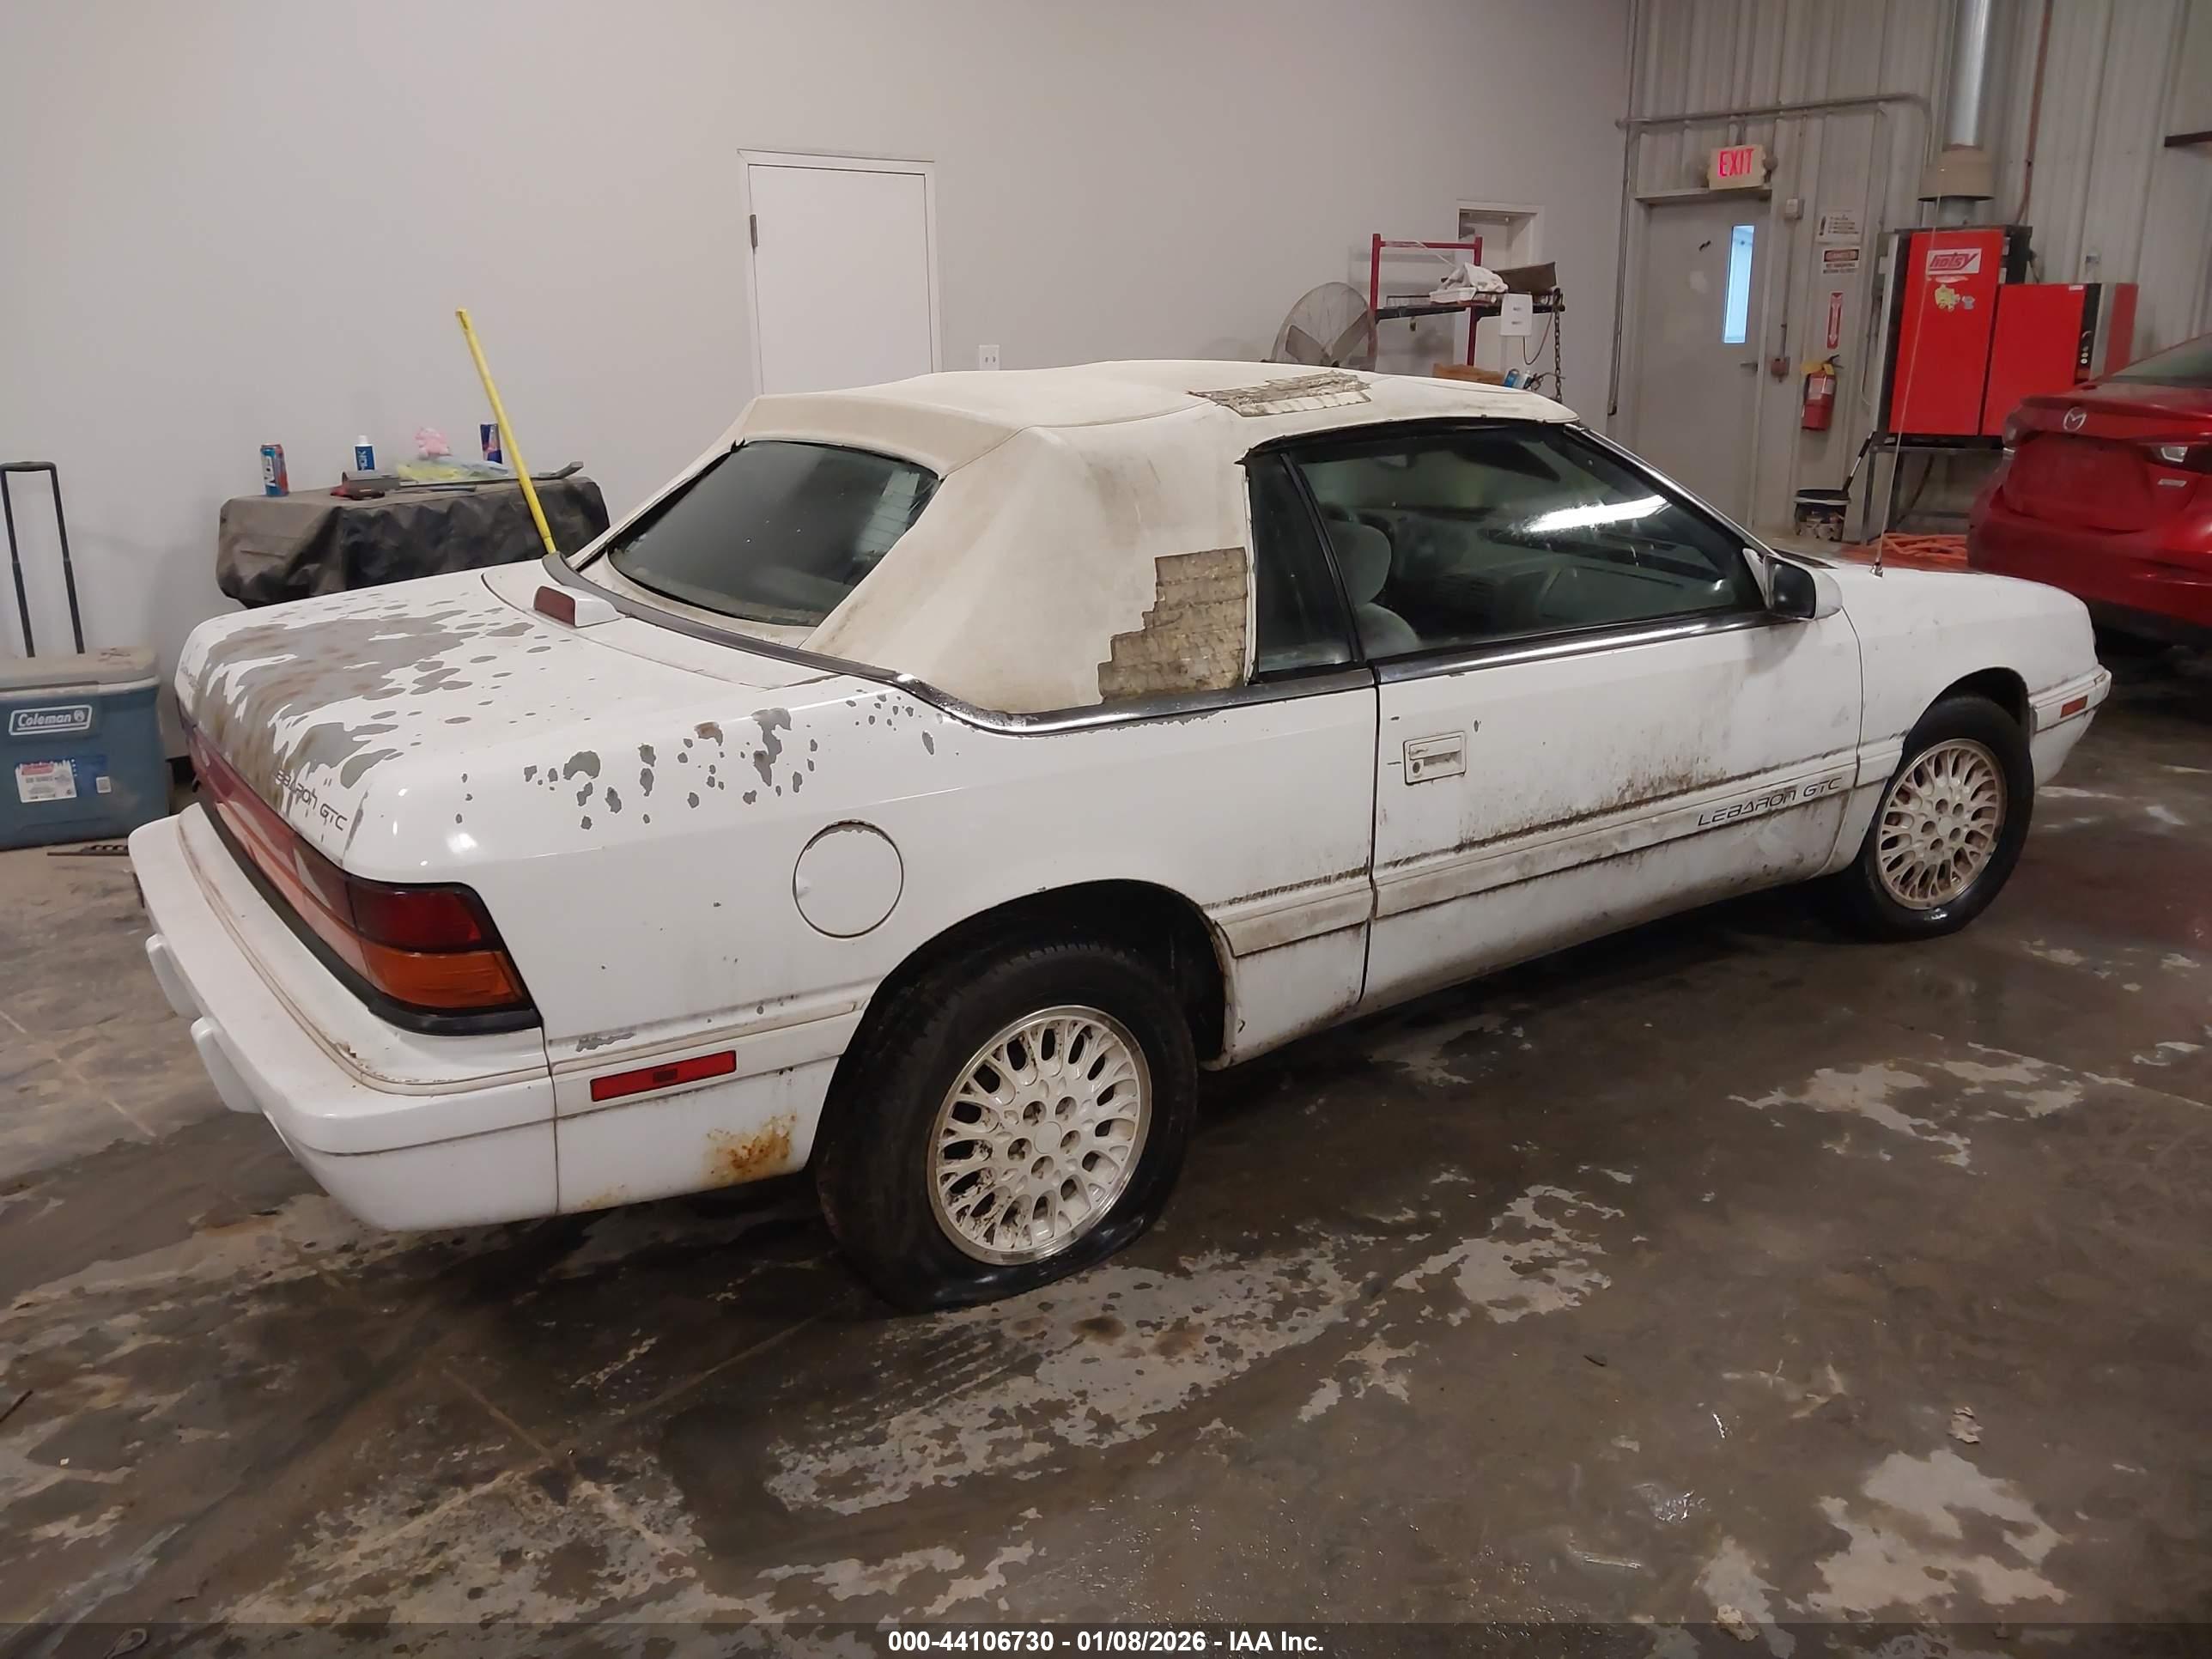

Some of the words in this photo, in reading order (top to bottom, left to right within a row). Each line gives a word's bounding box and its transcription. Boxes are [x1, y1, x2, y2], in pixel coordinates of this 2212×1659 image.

[1718, 148, 1753, 177] EXIT
[16, 712, 72, 727] Coleman
[1697, 788, 1797, 827] LEBARON
[1802, 776, 1843, 798] GTC
[319, 803, 349, 831] GTC
